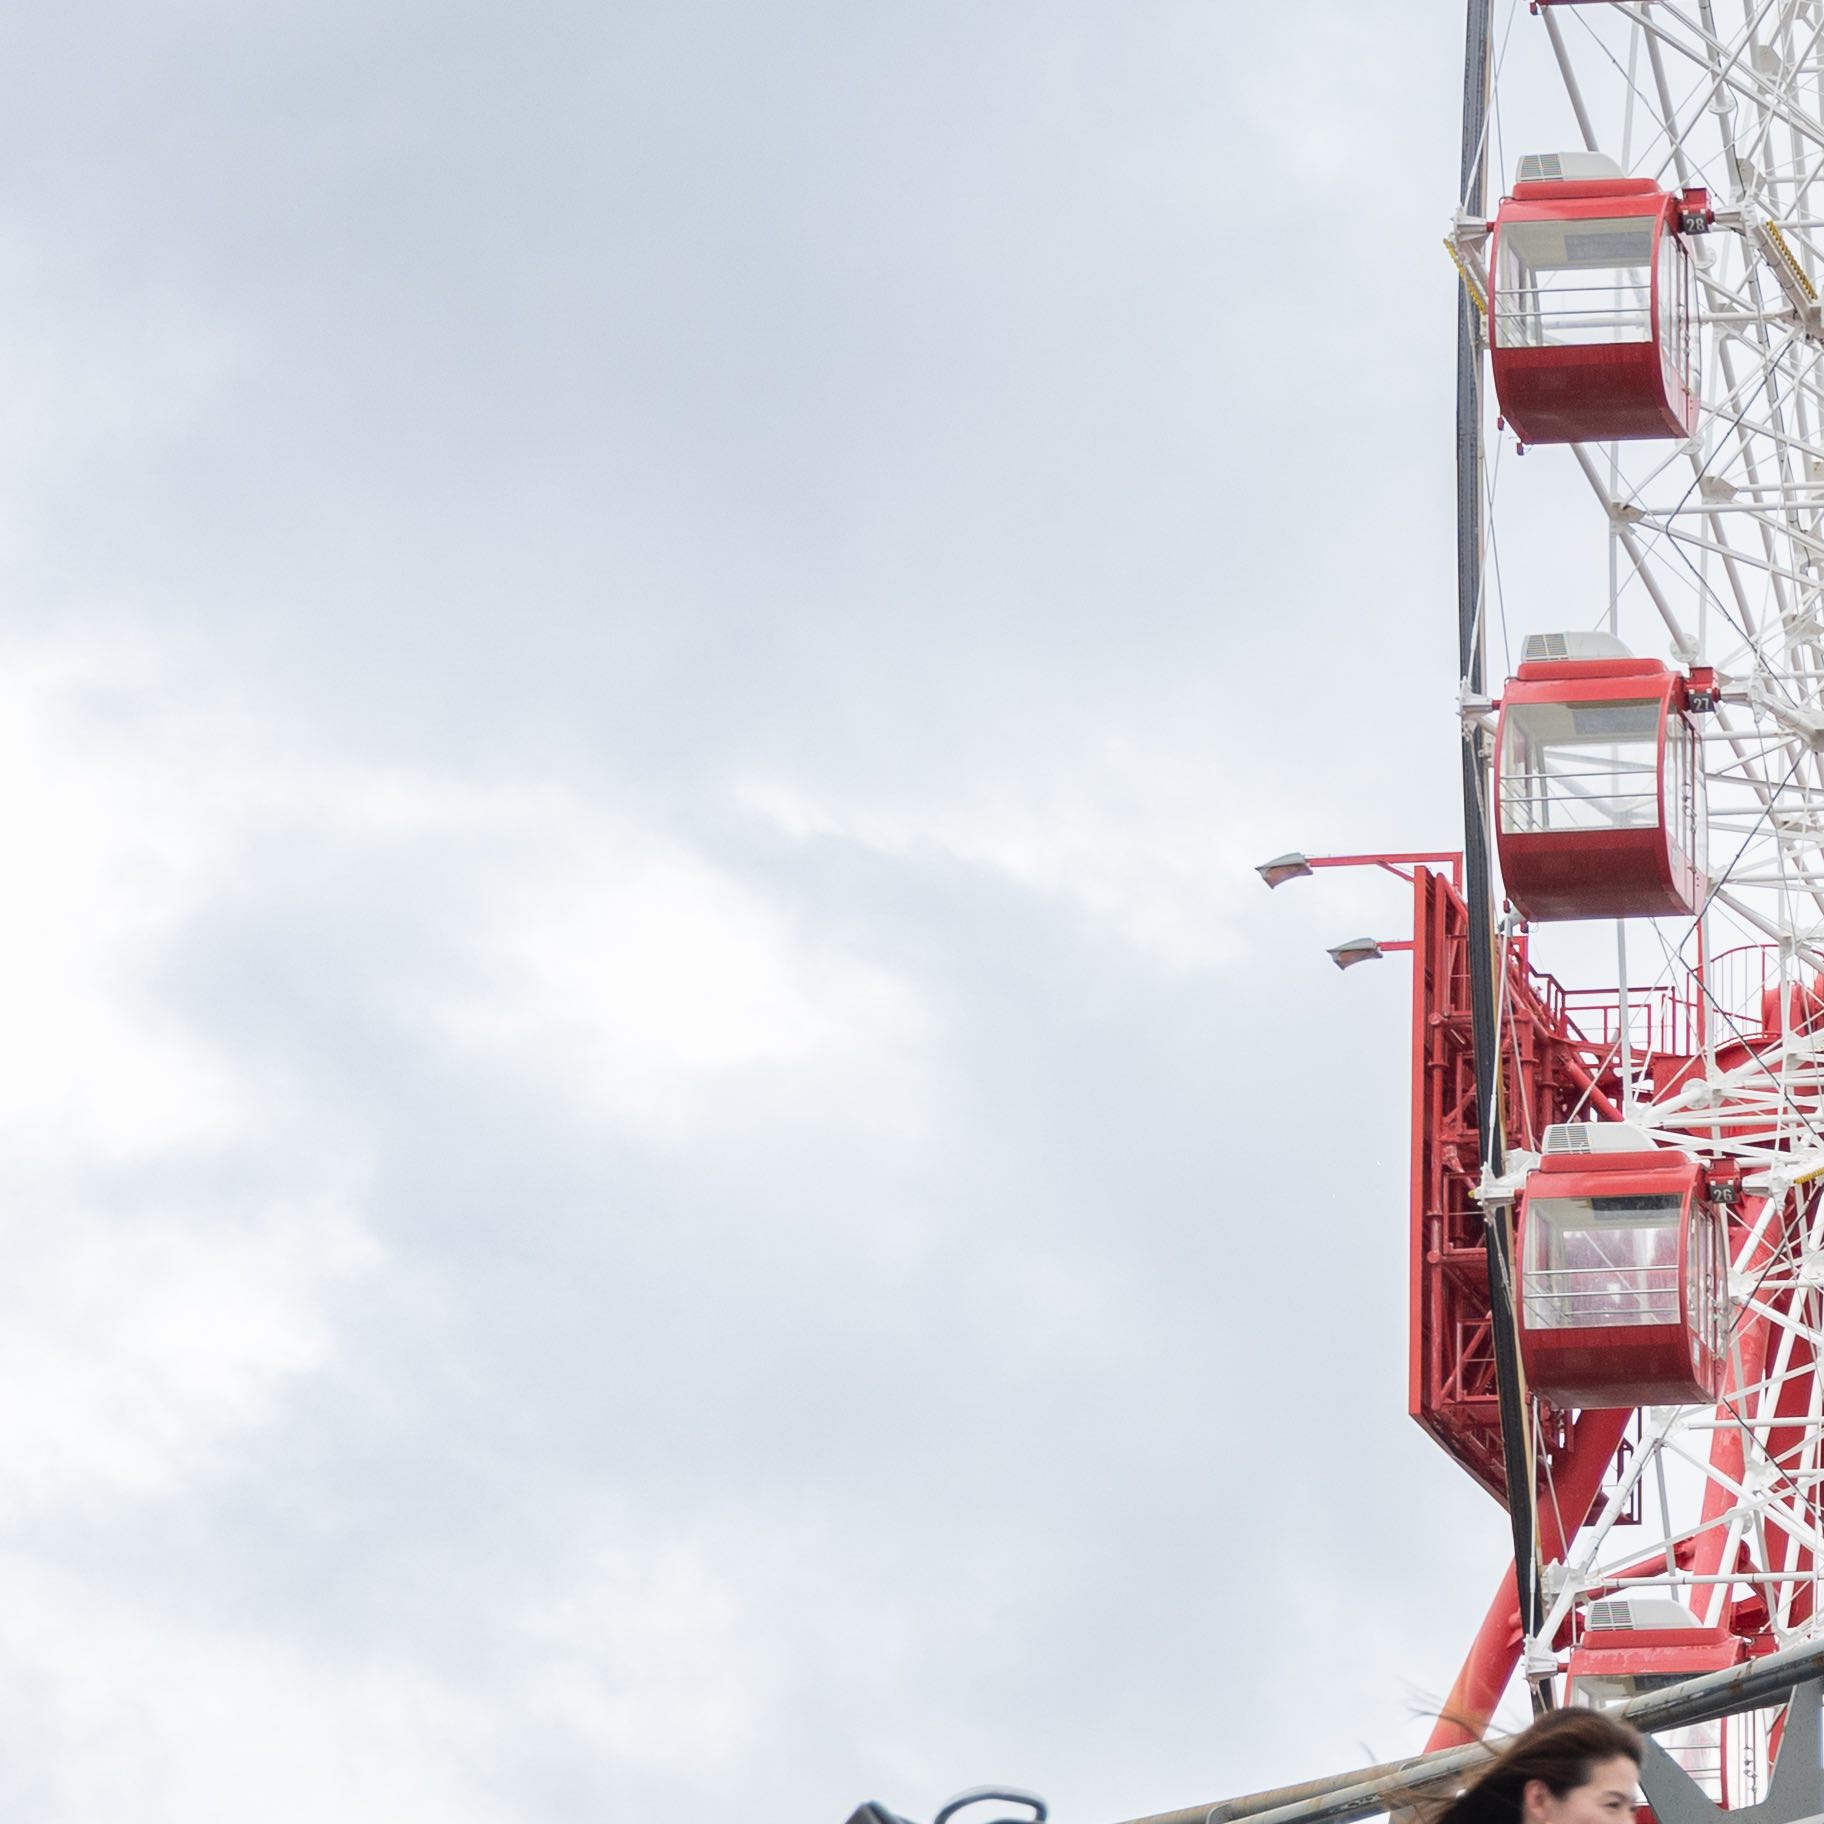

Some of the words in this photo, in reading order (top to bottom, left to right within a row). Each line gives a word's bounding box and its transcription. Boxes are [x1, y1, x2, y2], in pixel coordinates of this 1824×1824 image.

[1686, 217, 1705, 232] 28
[1693, 697, 1710, 711] 27
[1713, 1188, 1733, 1202] 26
